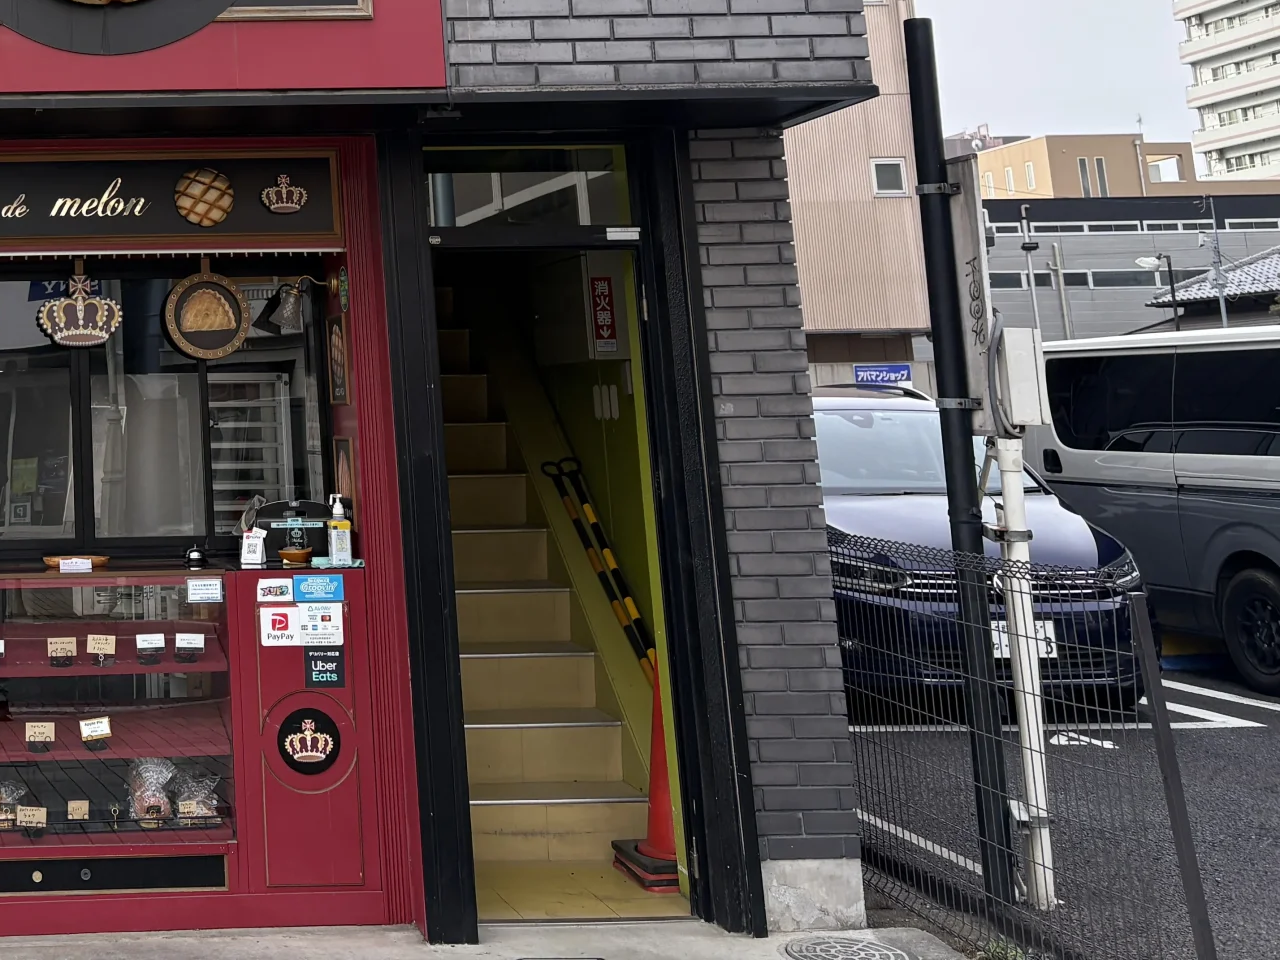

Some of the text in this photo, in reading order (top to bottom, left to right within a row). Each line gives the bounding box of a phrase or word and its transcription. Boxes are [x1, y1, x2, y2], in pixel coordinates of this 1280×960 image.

[1, 193, 30, 218] de
[49, 177, 152, 218] melon
[594, 280, 612, 325] 消火器
[857, 370, 908, 382] アパマンショップ
[267, 633, 294, 641] PayPay
[311, 660, 337, 671] Uber
[312, 672, 338, 681] Eats
